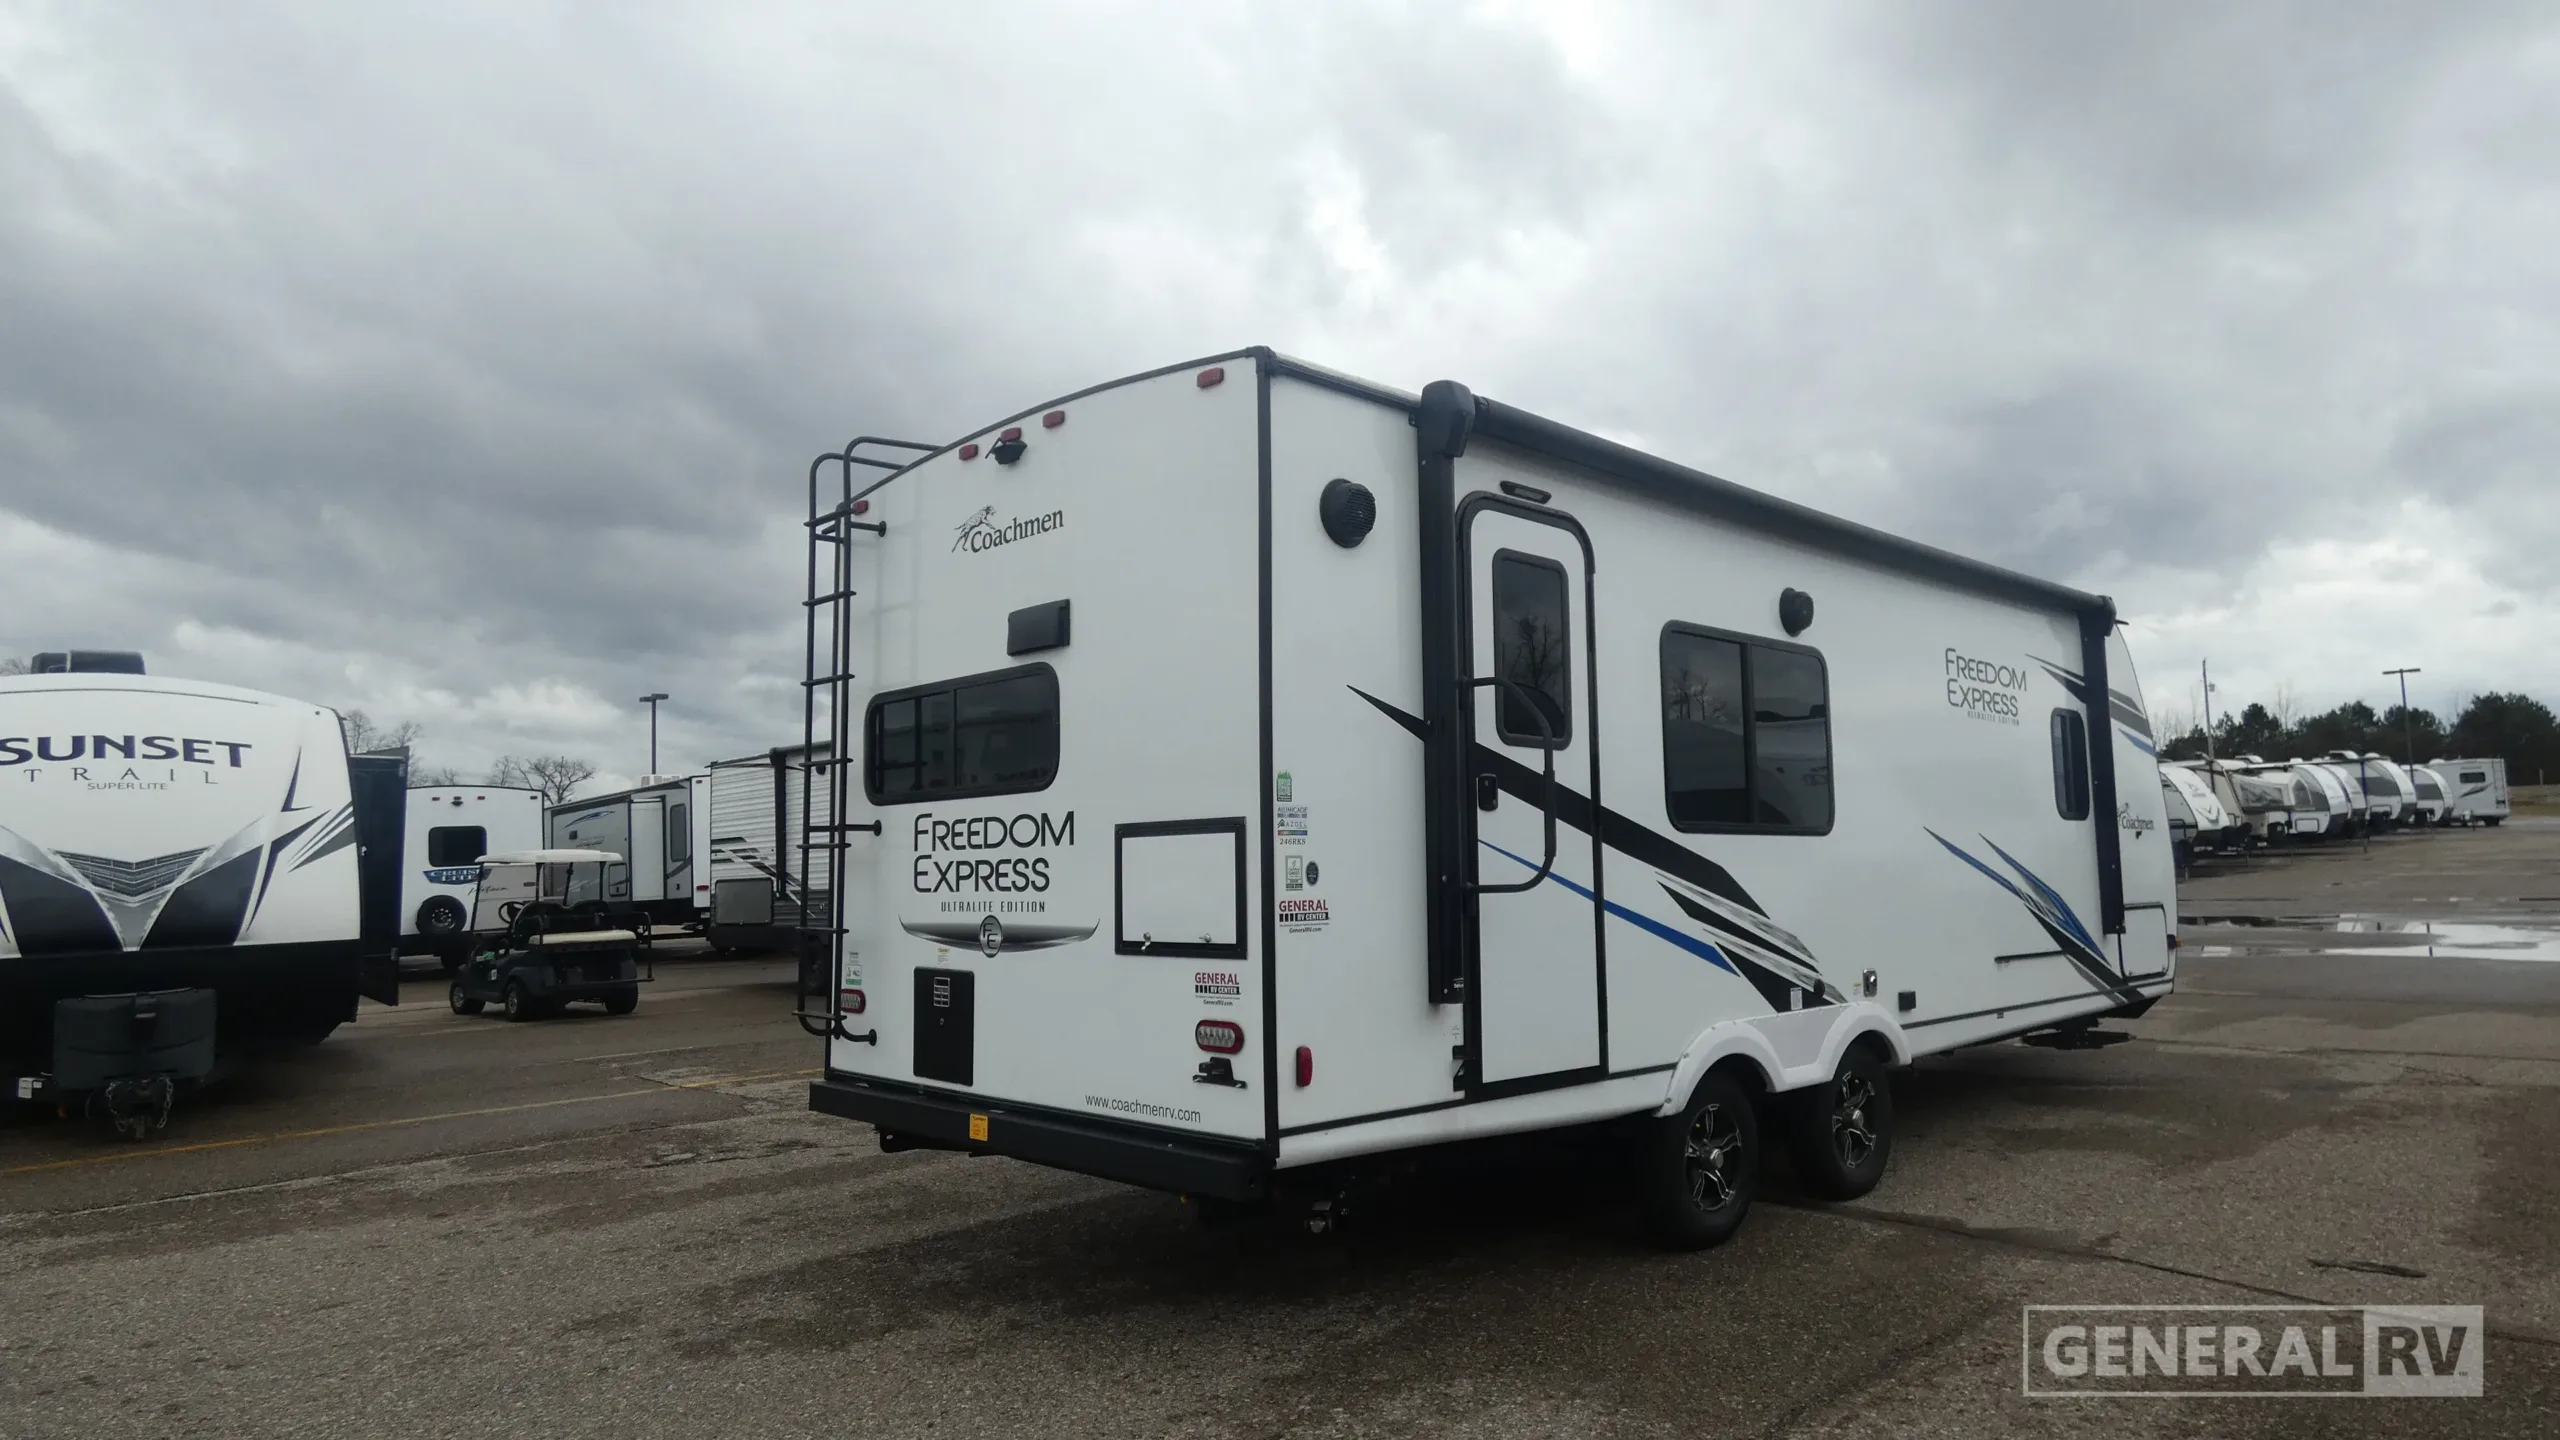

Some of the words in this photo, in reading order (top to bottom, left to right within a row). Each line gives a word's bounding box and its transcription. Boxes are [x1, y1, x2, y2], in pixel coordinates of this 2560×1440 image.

[970, 509, 1064, 553] Coachmen
[1945, 647, 2028, 692] FREEDOM
[1947, 678, 2019, 718] EXPRESS
[87, 782, 135, 790] SUPER
[139, 782, 168, 790] LITE
[913, 810, 1075, 852] FREEDOM
[913, 854, 1050, 893] EXPRESS
[940, 901, 994, 913] ULTRALITE
[1000, 901, 1045, 913] EDITION
[1278, 899, 1329, 912] GENERAL
[1297, 913, 1305, 921] RV
[1305, 912, 1327, 920] CENTER
[1194, 972, 1240, 985] GENERAL
[1085, 1095, 1201, 1123] www.coachmenrv.com
